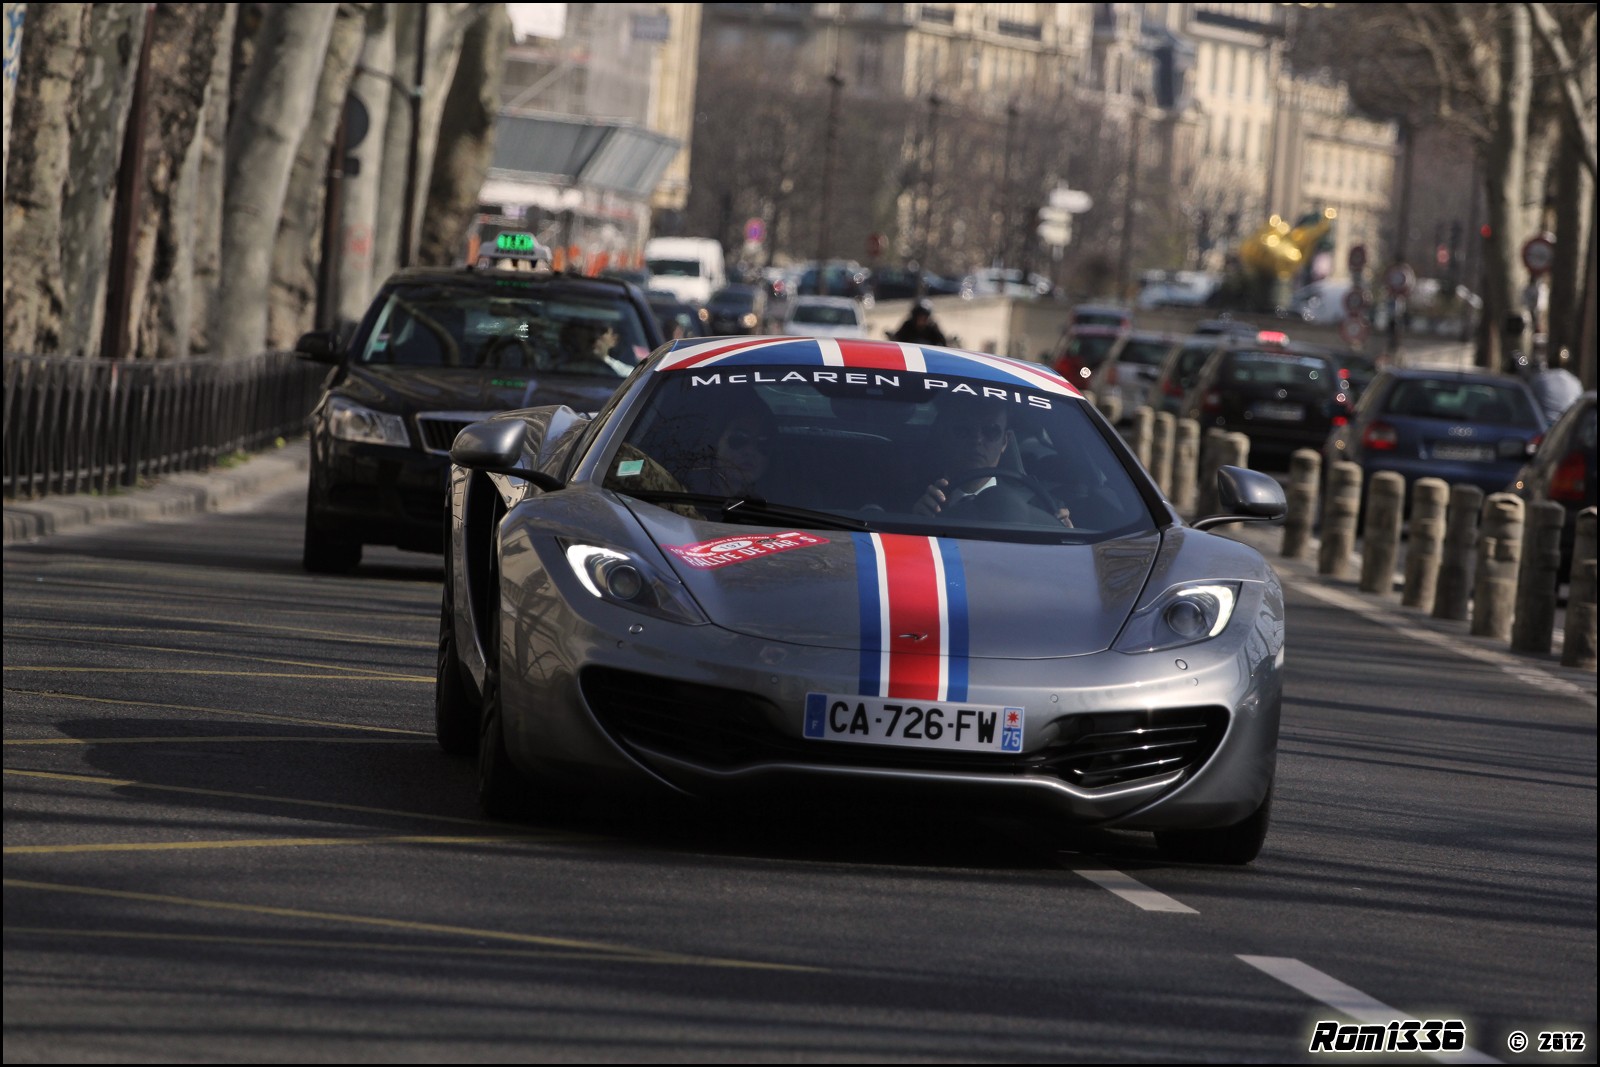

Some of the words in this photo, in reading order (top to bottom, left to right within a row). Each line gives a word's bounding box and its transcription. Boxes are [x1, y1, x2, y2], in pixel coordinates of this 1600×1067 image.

[691, 370, 901, 387] McLAREN
[923, 378, 1053, 411] PARIS
[682, 552, 742, 567] RALLYE
[737, 546, 766, 556] DE
[762, 535, 817, 550] PARS
[811, 720, 819, 730] F
[829, 701, 997, 744] CA-726-FW
[1003, 731, 1020, 748] 75
